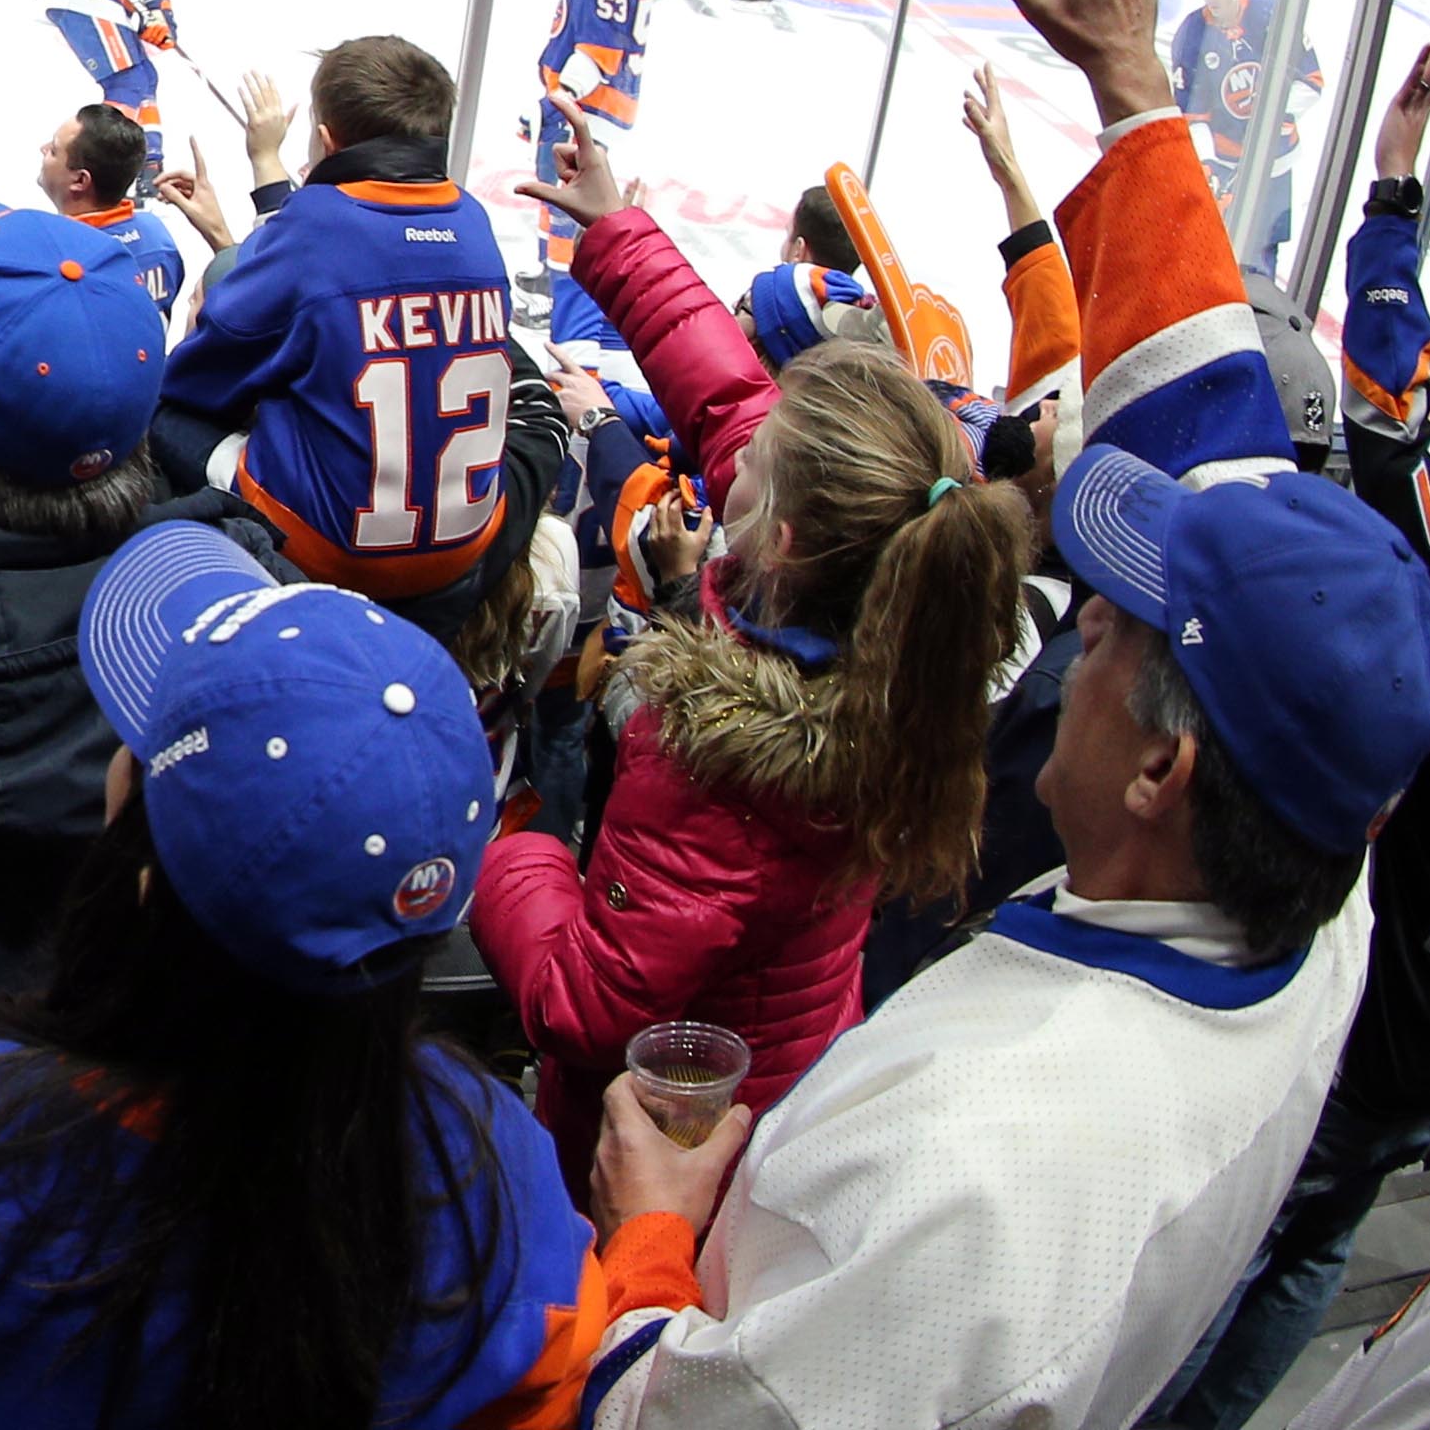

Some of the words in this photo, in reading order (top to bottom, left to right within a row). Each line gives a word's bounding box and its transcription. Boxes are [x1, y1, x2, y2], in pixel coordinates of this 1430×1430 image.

[405, 228, 457, 243] Reebok
[358, 288, 507, 353] KEVIN
[351, 351, 514, 549] 12
[149, 725, 210, 778] Reebok
